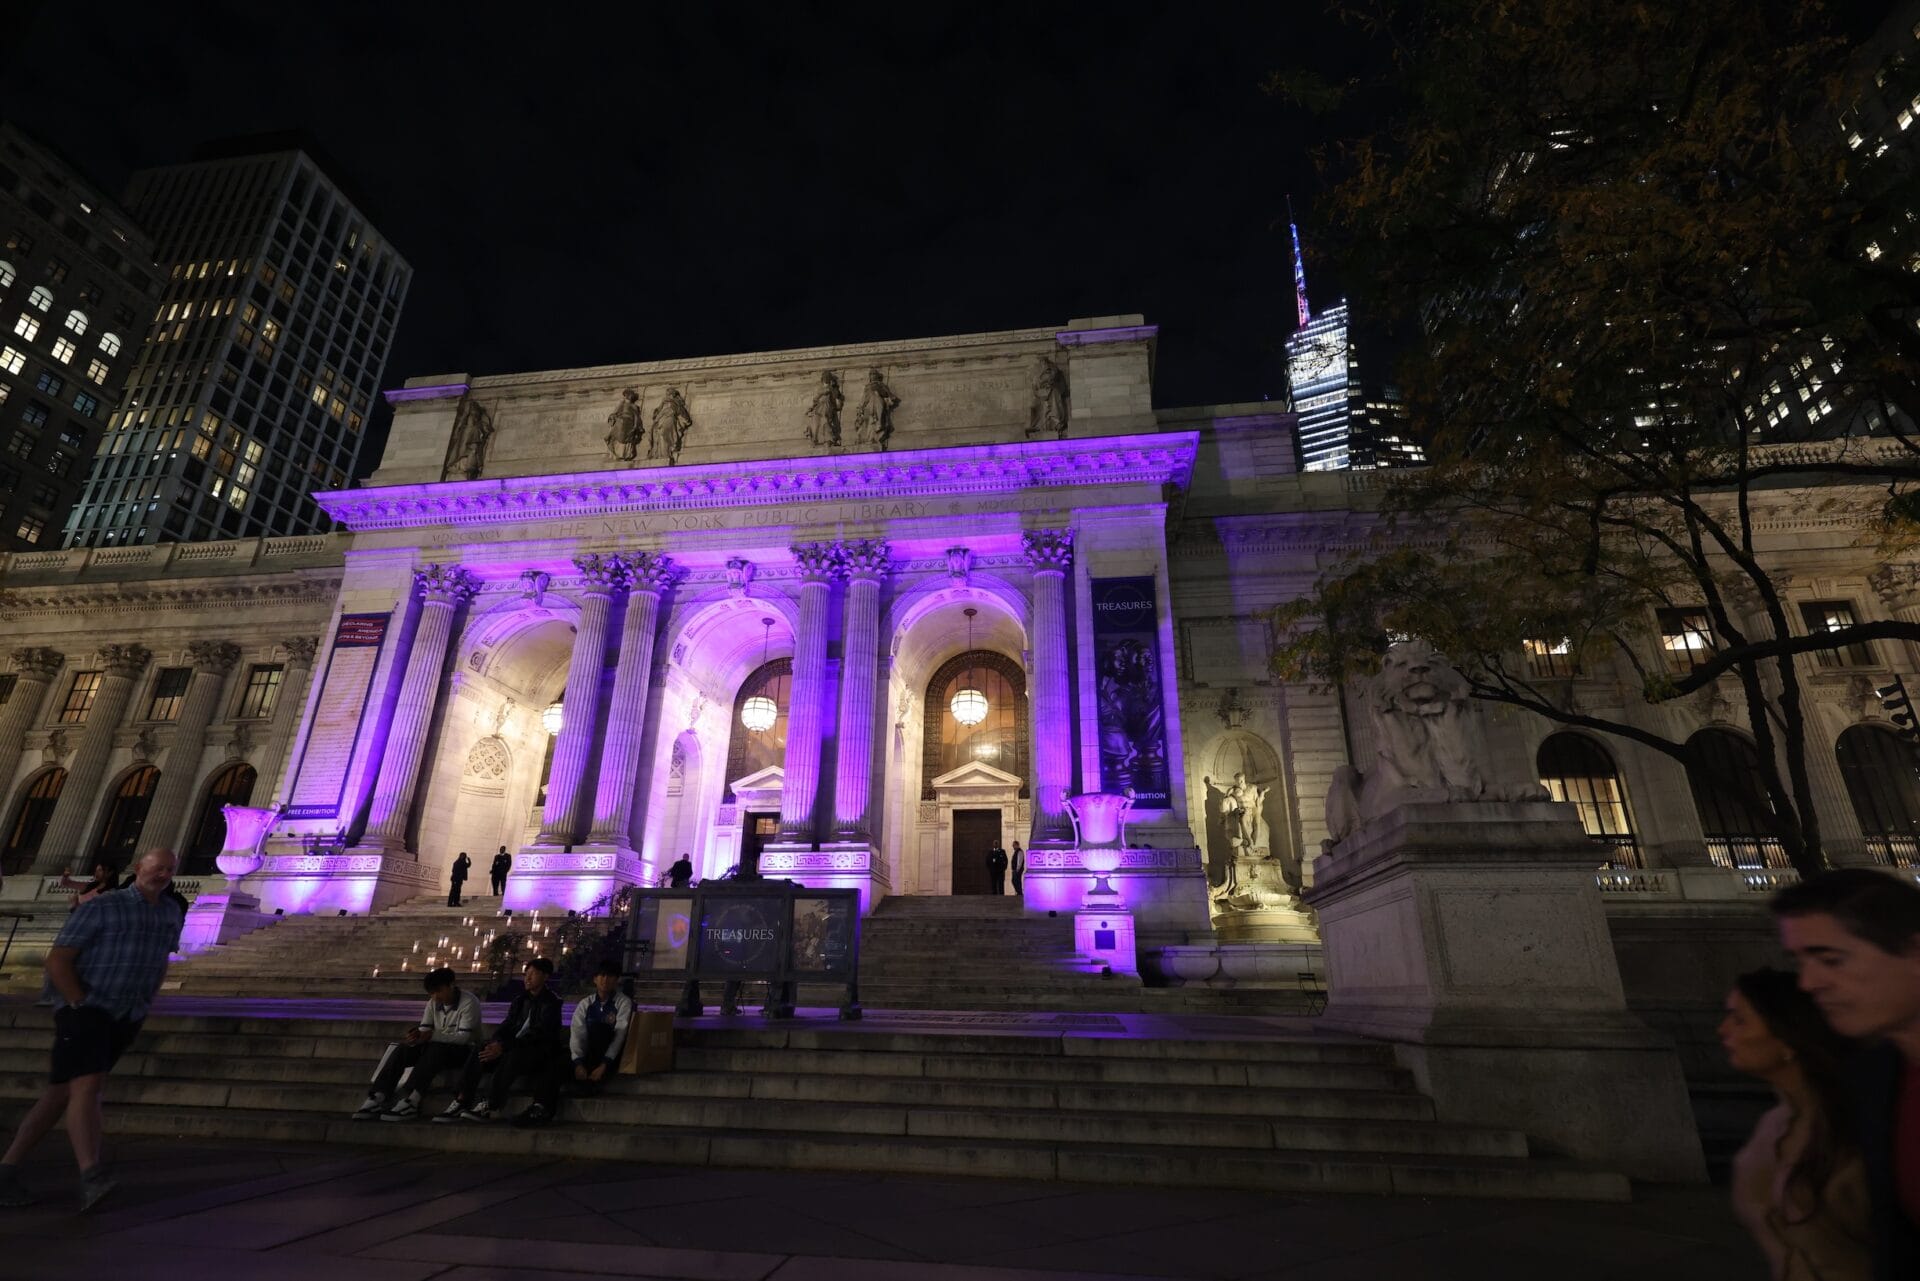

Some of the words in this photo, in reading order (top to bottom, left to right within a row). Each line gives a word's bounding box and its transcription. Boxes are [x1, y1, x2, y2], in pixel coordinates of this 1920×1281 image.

[546, 522, 586, 538] THE
[602, 518, 655, 535] NEW
[672, 513, 727, 531] YORK
[742, 508, 819, 526] PUBLIC
[839, 502, 930, 521] LIBRARY
[1096, 600, 1153, 611] TREASURES
[706, 928, 774, 941] TREASURES
